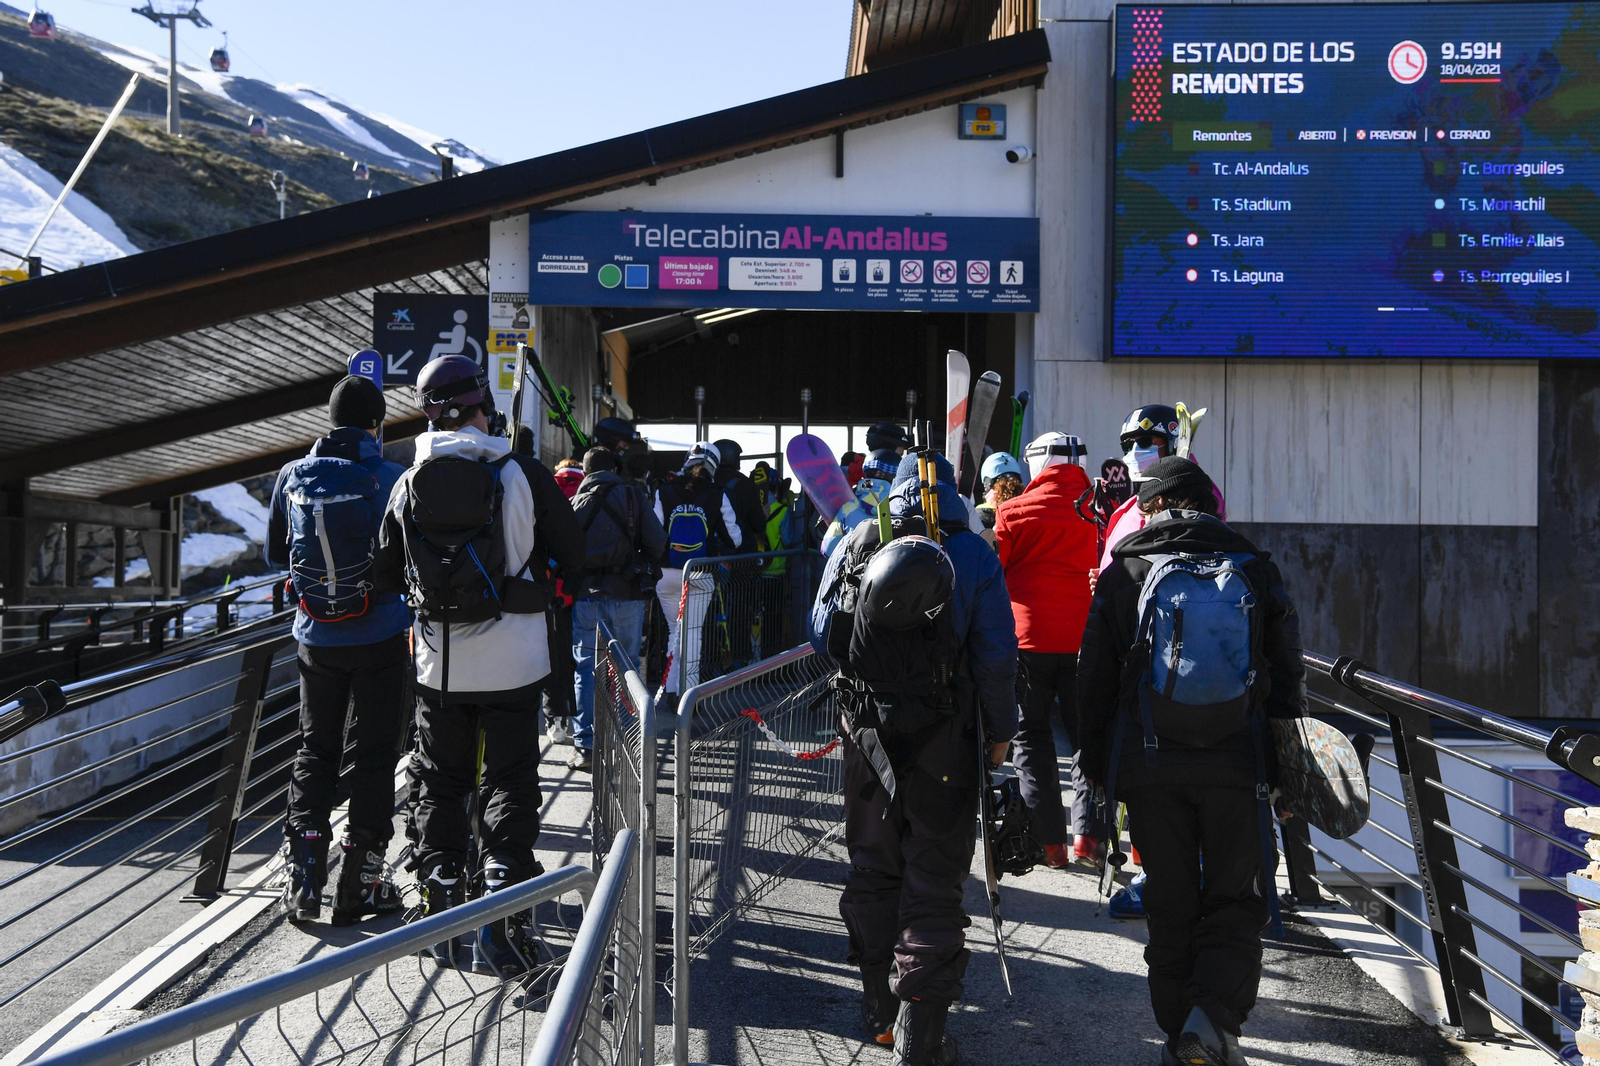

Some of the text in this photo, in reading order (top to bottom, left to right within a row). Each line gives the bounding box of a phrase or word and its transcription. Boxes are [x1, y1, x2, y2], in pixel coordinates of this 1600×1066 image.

[1173, 42, 1354, 63] ESTADO DE LOS
[1442, 43, 1501, 60] 9.59H
[1440, 64, 1501, 76] 18/04/2021
[1173, 73, 1304, 94] REMONTES
[1193, 130, 1252, 142] Remontes
[1298, 131, 1336, 140] ABIERTO
[1370, 130, 1416, 140] PREVISION
[1450, 130, 1490, 140] CERRADO
[1213, 162, 1309, 175] Tc. Al-Andalus
[1460, 161, 1564, 178] Tc. Borreguiles
[1212, 197, 1291, 212] Ts. Stadium
[1459, 197, 1545, 211] Ts. Monachil
[1212, 234, 1263, 247] Ts. Jara
[1459, 234, 1478, 247] Ts.
[1527, 233, 1564, 248] Allais
[664, 261, 713, 271] Última bajada
[1212, 270, 1283, 287] Ts. Laguna
[1459, 270, 1478, 283] Ts.
[1482, 270, 1562, 287] Borreguiles
